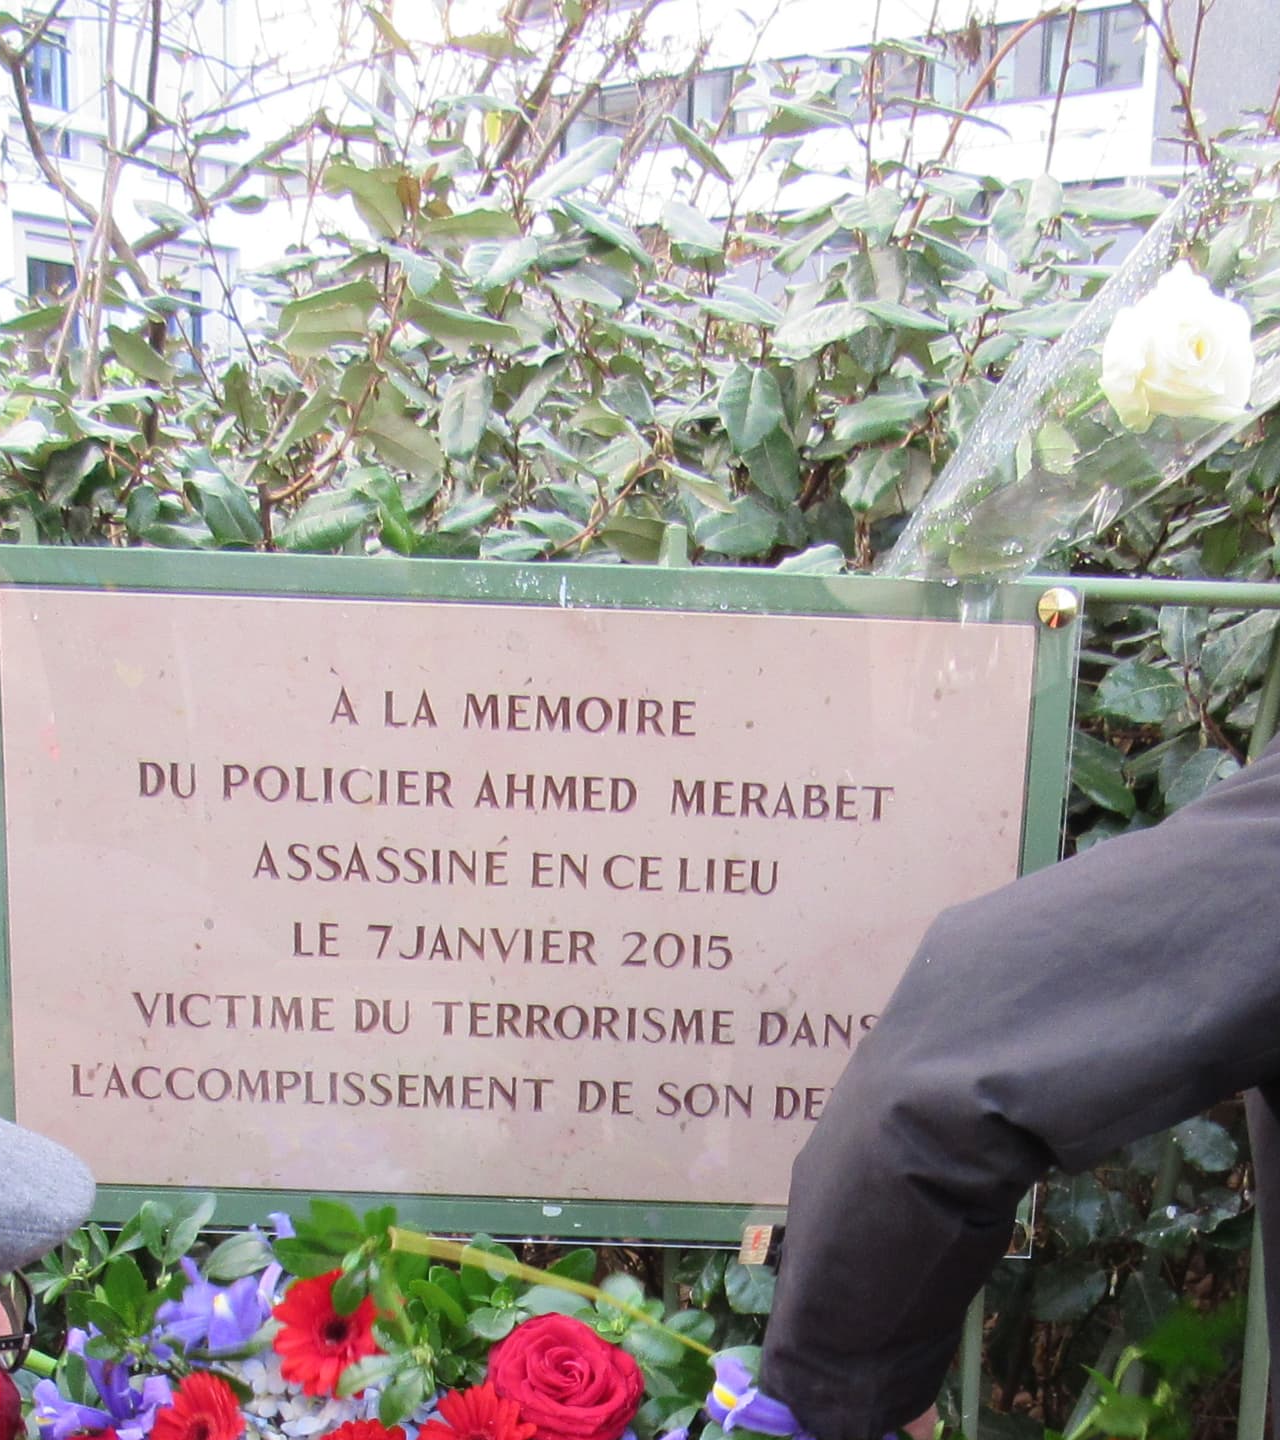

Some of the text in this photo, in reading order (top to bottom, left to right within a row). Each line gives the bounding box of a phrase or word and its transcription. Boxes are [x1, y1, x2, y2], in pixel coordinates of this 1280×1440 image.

[384, 688, 438, 730] LA
[463, 676, 697, 738] MÉMOIRE
[138, 761, 896, 823] DU POLICIER AHMED MERABET
[253, 835, 779, 896] ASSASSINÉ EN CE LIEU
[292, 921, 734, 971] LE 7 JANVIER 2015
[132, 990, 336, 1034] VICTIME
[354, 998, 411, 1036] DU
[431, 1000, 736, 1046] TERRORISME
[70, 1061, 832, 1121] L'ACCOMPLISSEMENT DE SON DE
